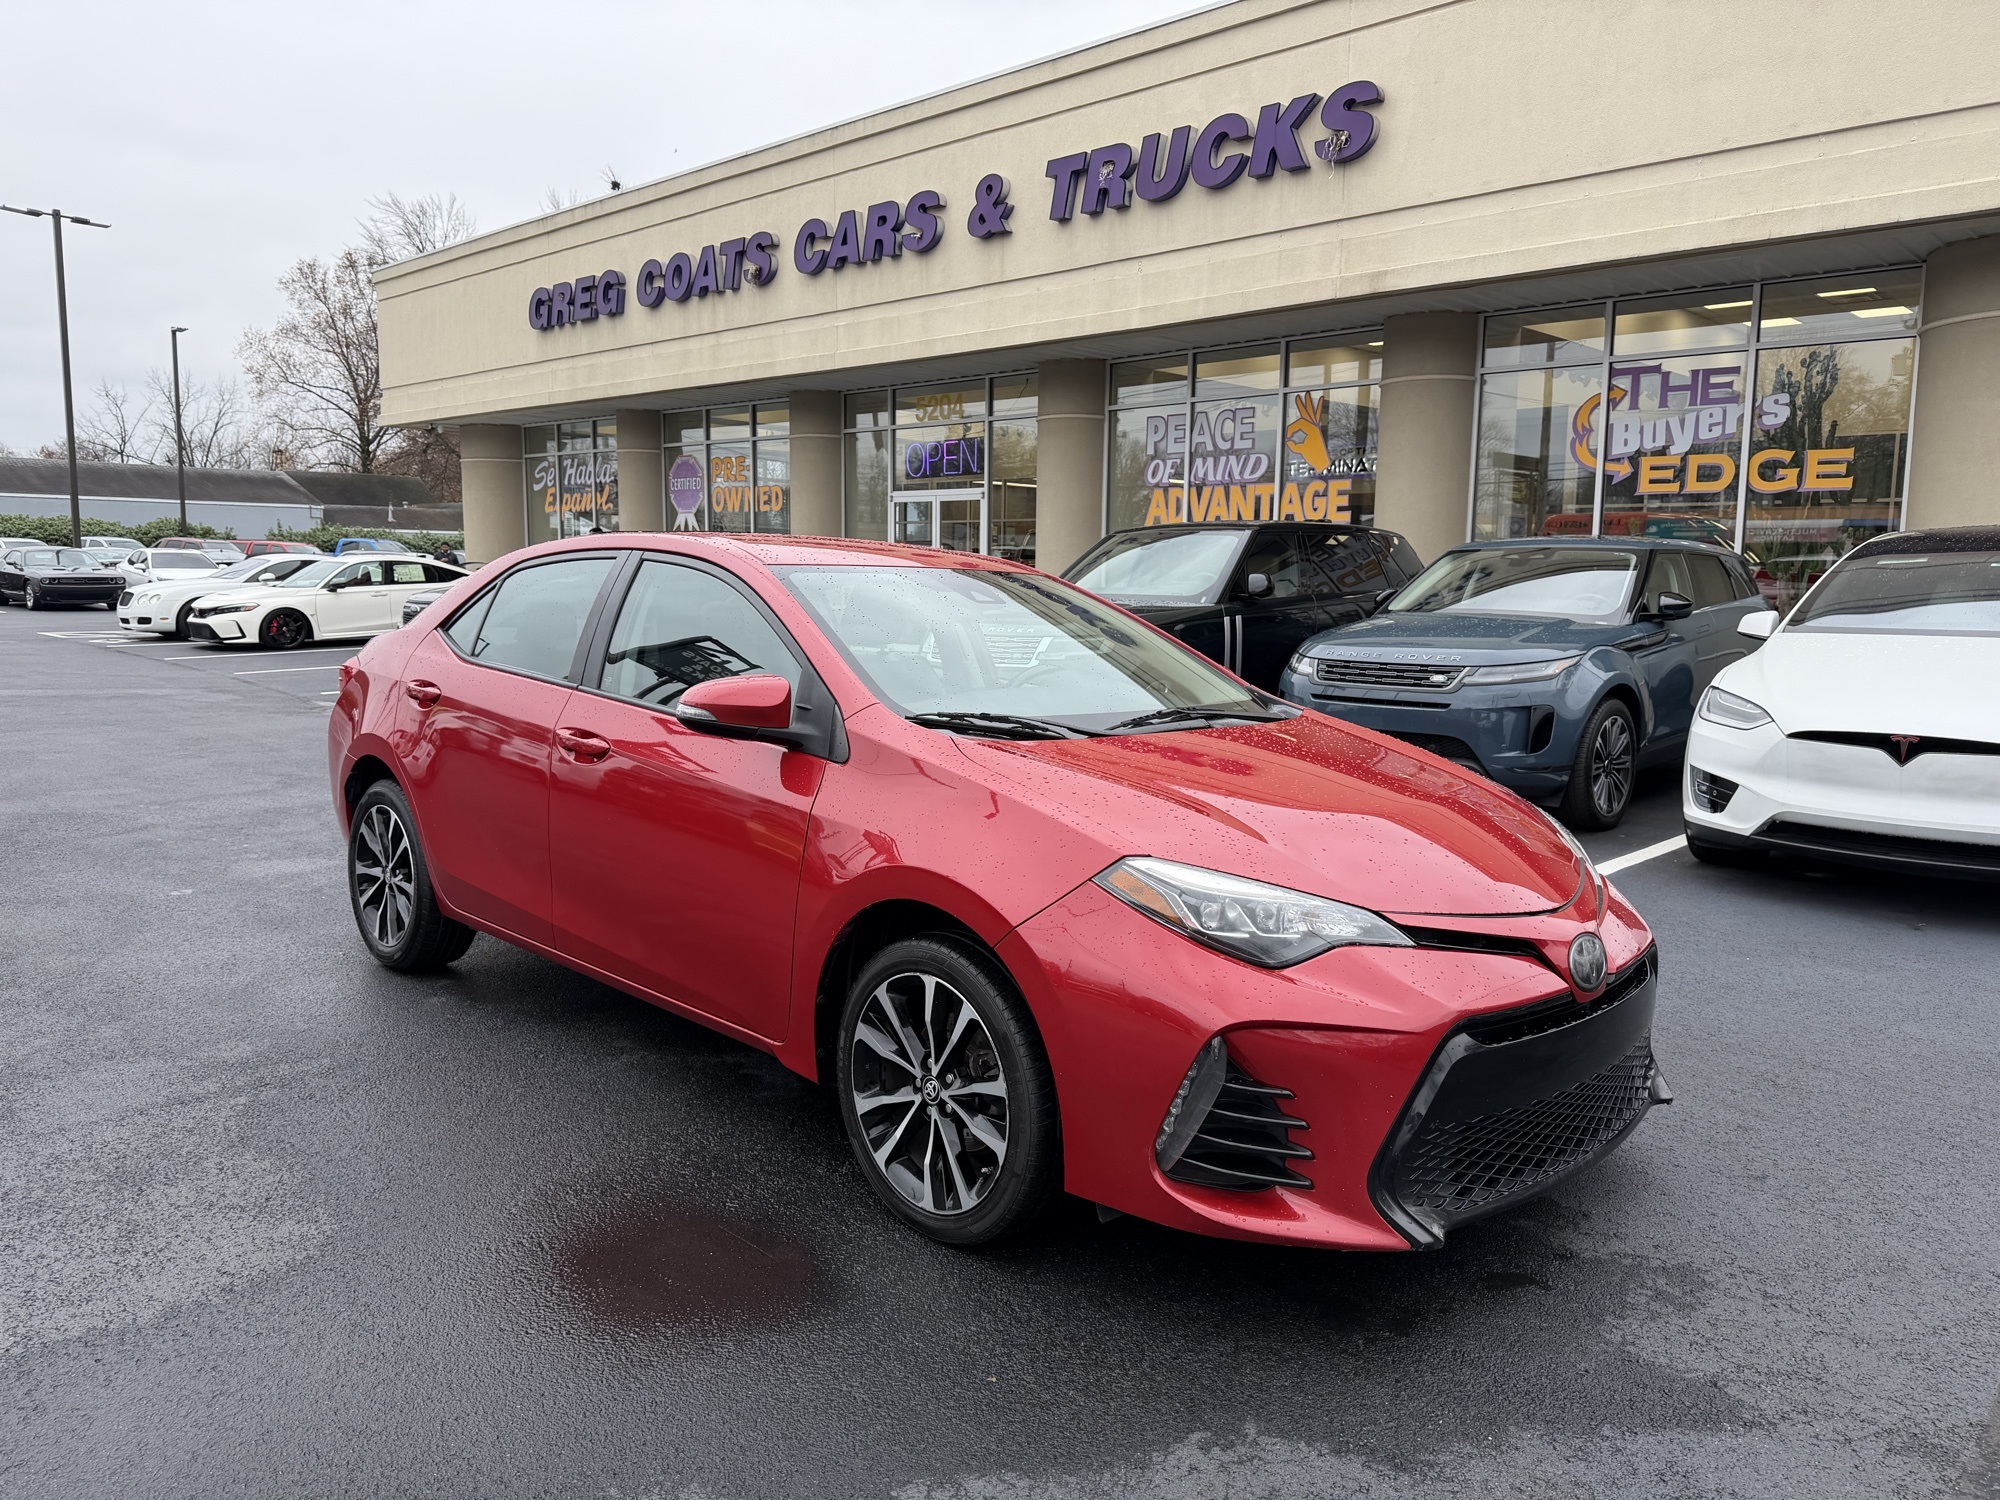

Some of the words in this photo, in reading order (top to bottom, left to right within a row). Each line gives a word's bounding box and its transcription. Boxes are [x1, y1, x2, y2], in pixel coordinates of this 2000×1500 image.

[528, 269, 626, 330] GREG
[637, 231, 780, 308] COATS
[794, 190, 946, 276] CARS
[967, 173, 1015, 240] &
[1045, 80, 1385, 223] TRUCKS
[1611, 363, 1741, 412] THE
[915, 393, 964, 422] 5204
[1145, 406, 1256, 455] PEACE
[533, 460, 555, 491] Se
[563, 456, 614, 485] Habla
[711, 455, 751, 483] PRE-
[906, 438, 978, 477] OPEN
[1145, 458, 1181, 486] OF
[1190, 452, 1271, 485] MIND
[1634, 447, 1855, 496] EDGE
[670, 477, 702, 491] CERTIFIED
[712, 484, 783, 513] OWNED
[1145, 478, 1352, 526] ADVANTAGE
[545, 484, 614, 521] Epañol
[1325, 649, 1382, 659] RANGE
[1394, 653, 1462, 662] ROVER
